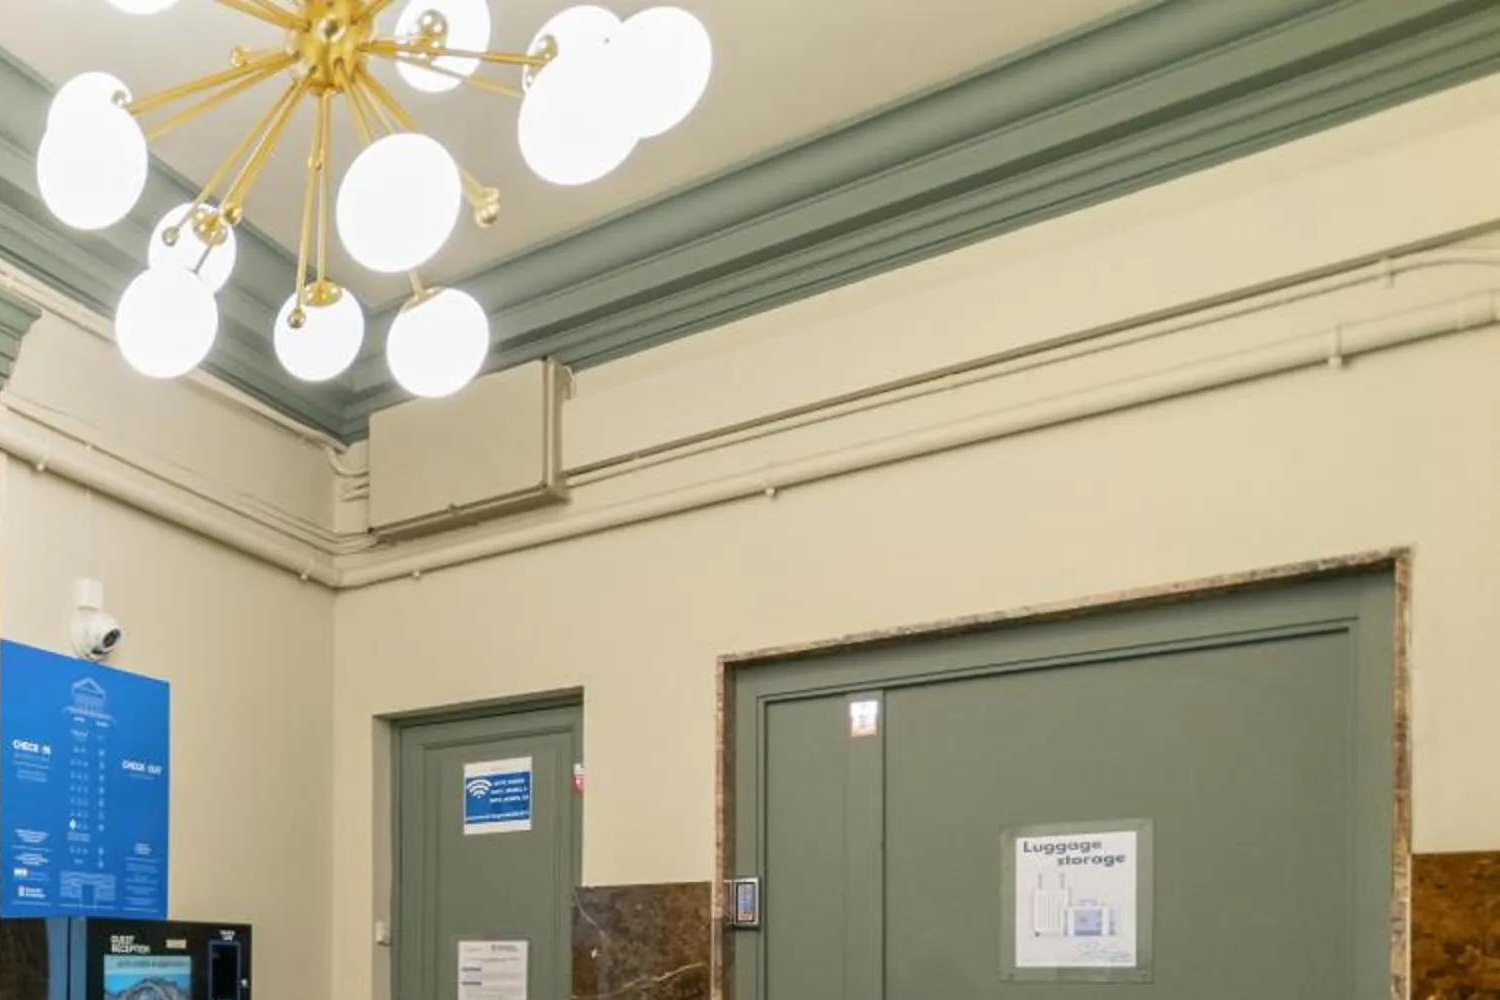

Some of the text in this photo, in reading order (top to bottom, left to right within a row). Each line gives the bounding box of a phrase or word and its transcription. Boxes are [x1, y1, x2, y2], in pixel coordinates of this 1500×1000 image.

[12, 739, 39, 753] CHECK
[122, 759, 145, 772] CHECK
[1023, 840, 1102, 855] Luggage
[1057, 854, 1126, 868] storage
